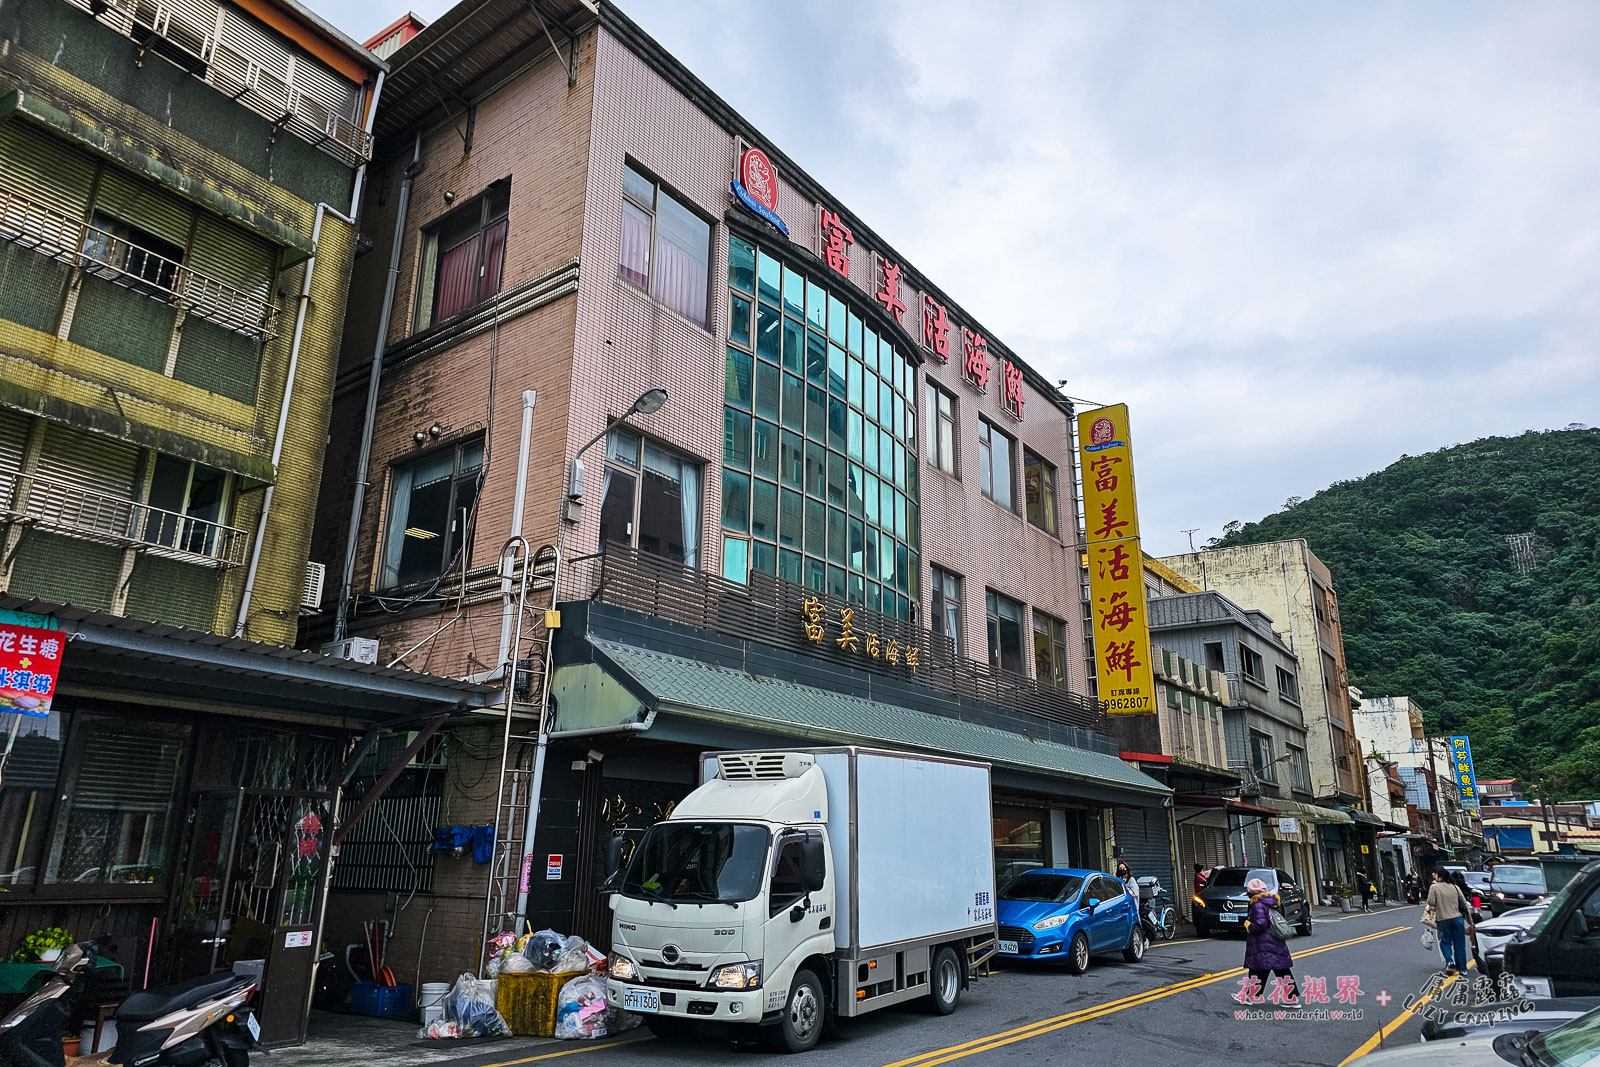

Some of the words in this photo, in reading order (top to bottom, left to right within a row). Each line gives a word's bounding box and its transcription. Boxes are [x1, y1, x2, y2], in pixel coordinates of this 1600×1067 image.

[821, 208, 1027, 418] 富美活海鮮
[1089, 455, 1141, 682] 富美活海鮮
[0, 630, 59, 660] 花生糖
[803, 596, 920, 675] 富美活海鮮
[619, 922, 637, 931] HINO
[624, 994, 658, 1009] RFH-1308
